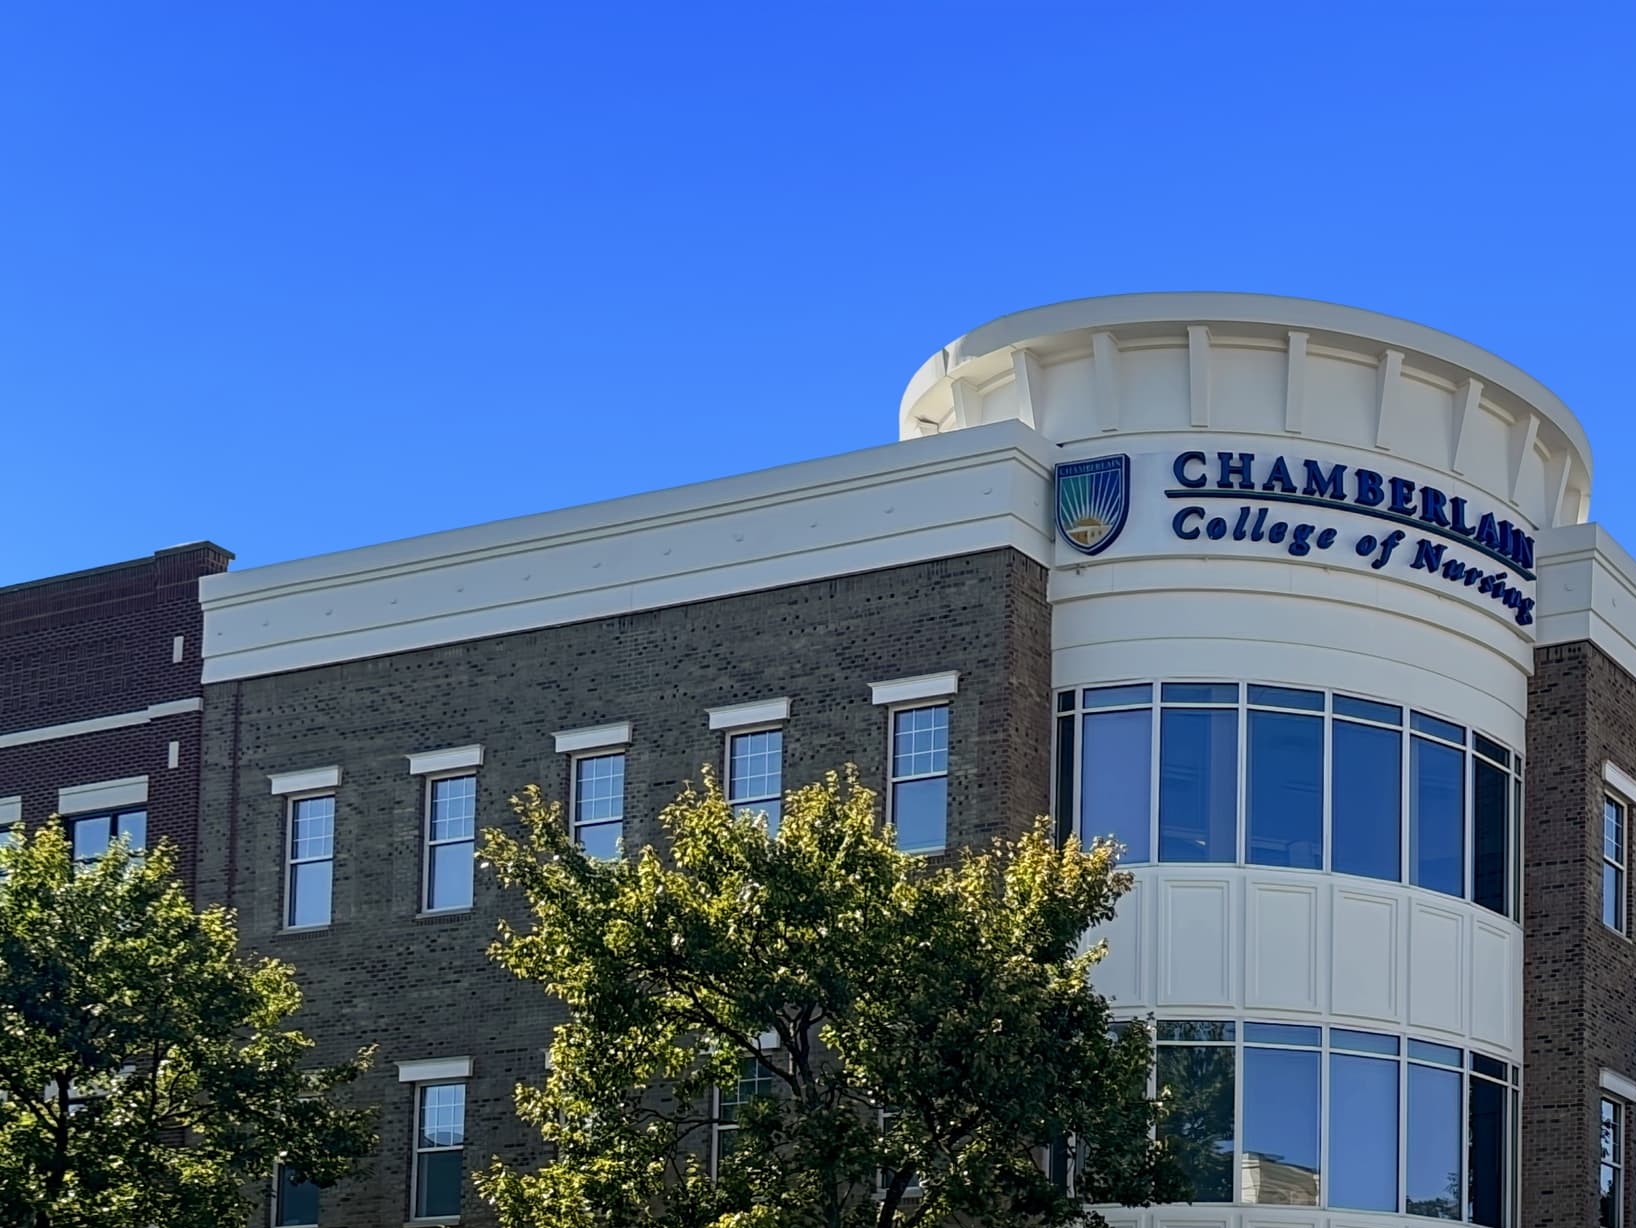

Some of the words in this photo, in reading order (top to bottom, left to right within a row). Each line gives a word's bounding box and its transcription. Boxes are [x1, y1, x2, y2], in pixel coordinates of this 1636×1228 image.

[1172, 506, 1337, 557] College
[1356, 530, 1406, 570] of
[1410, 539, 1536, 626] Nursing
[1173, 451, 1535, 569] CHAMBERLAIN
